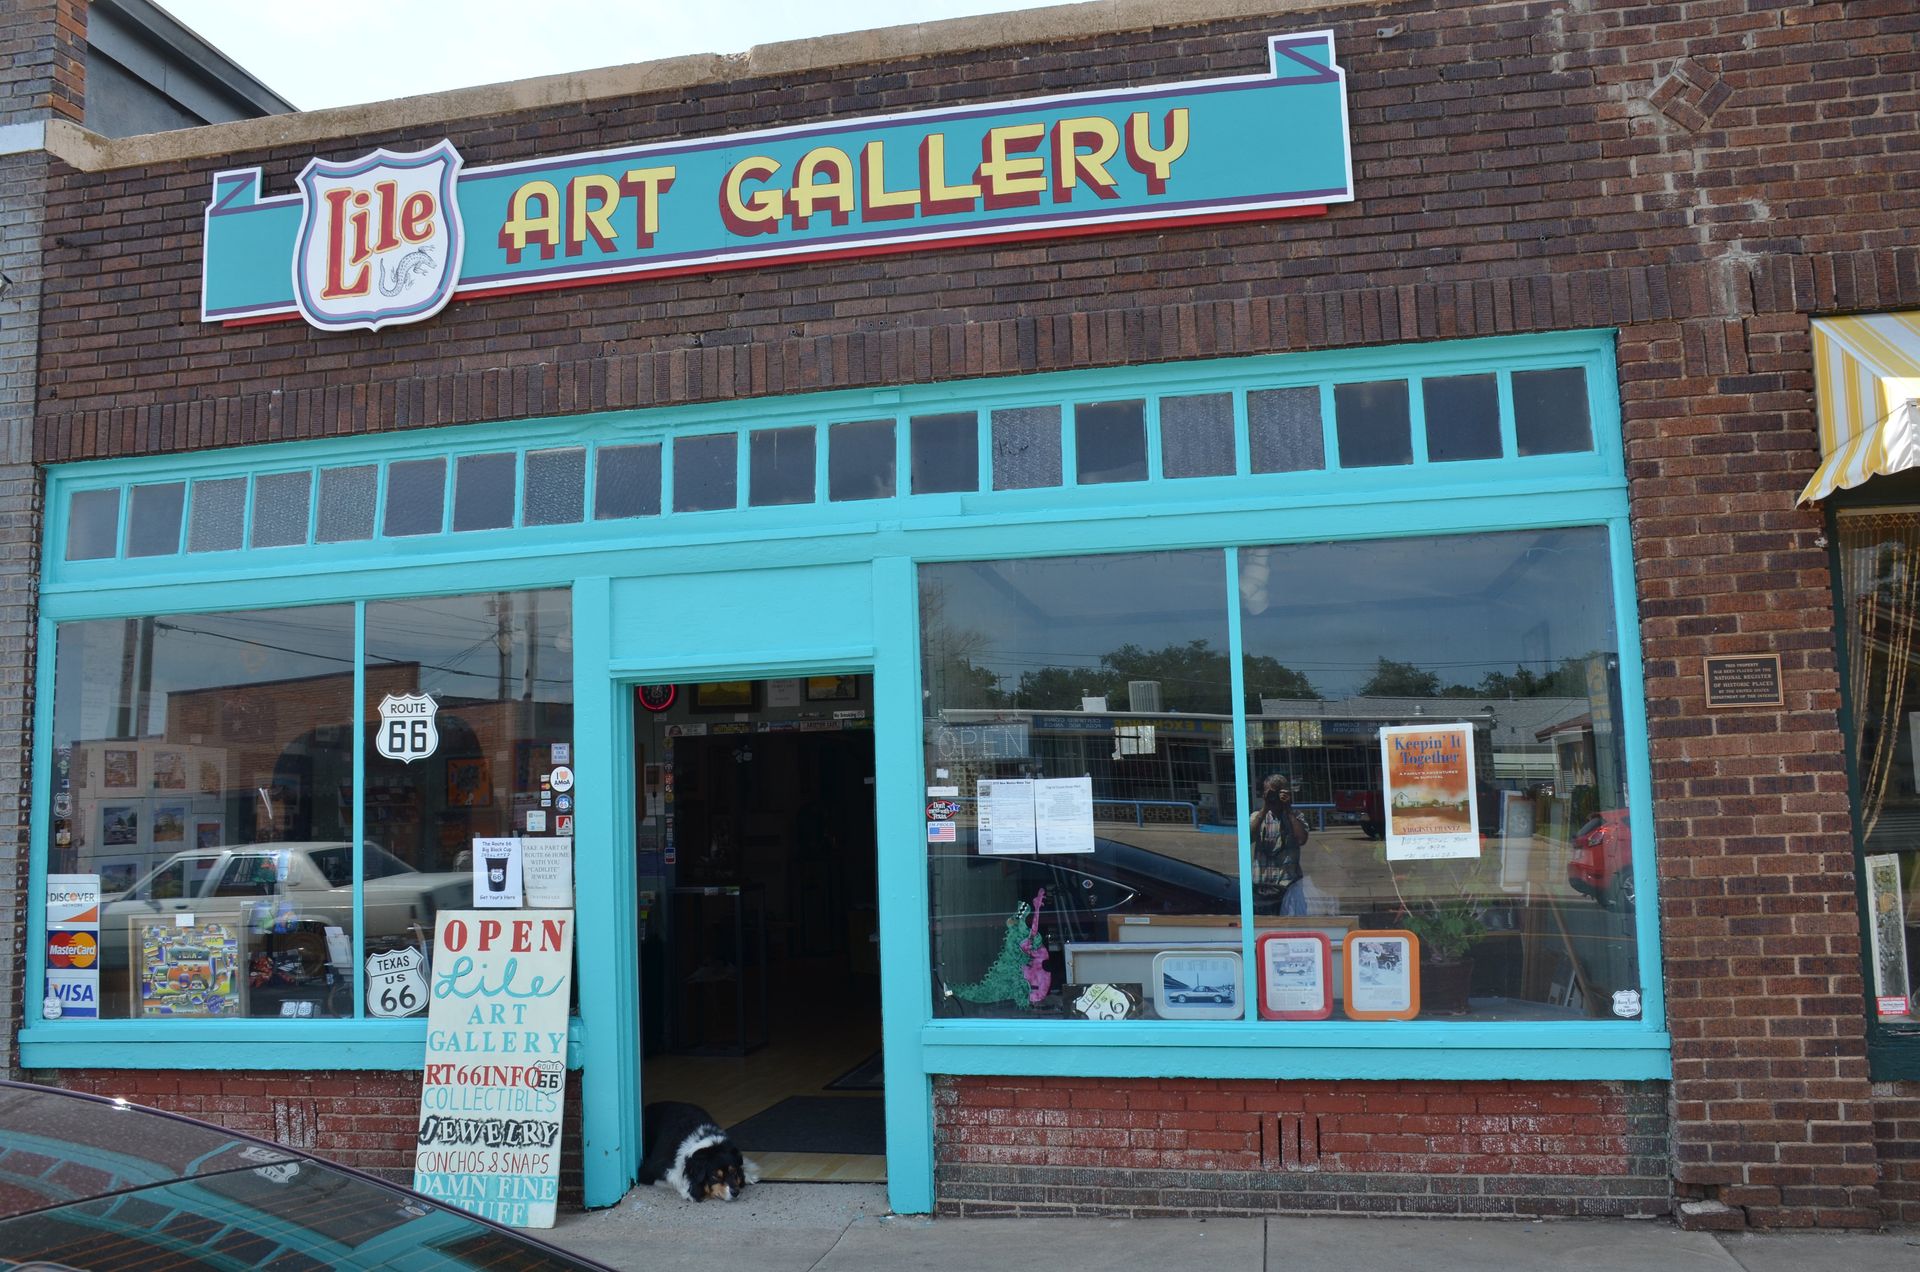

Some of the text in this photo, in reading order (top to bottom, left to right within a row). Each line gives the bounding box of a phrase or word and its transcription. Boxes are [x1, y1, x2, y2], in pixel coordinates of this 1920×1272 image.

[320, 107, 1189, 301] Lile ART GALLERY
[390, 702, 426, 714] ROUTE
[388, 720, 427, 753] 66
[938, 728, 1023, 758] OPEN
[1395, 735, 1462, 753] Keepin' It
[1400, 750, 1460, 770] Together
[1402, 825, 1433, 833] VIRGINIA
[50, 891, 95, 902] DISCOVER
[443, 919, 566, 953] OPEN
[49, 944, 97, 957] MasterCard
[377, 955, 410, 971] TEXAS
[385, 973, 406, 984] US
[434, 956, 565, 999] Lile
[52, 983, 95, 1002] VISA
[381, 984, 416, 1012] 66
[1082, 984, 1102, 1006] TEXAS
[1093, 997, 1108, 1010] US
[467, 1004, 528, 1025] ART
[428, 1030, 566, 1054] GALLERY
[537, 1062, 560, 1071] ROUTE
[538, 1073, 560, 1089] 66
[423, 1087, 558, 1113] COLLECTIBLES
[419, 1116, 560, 1147] JEWELRY
[416, 1151, 550, 1174] CONCHOS & SNAPS
[415, 1174, 556, 1202] DAMN FINE
